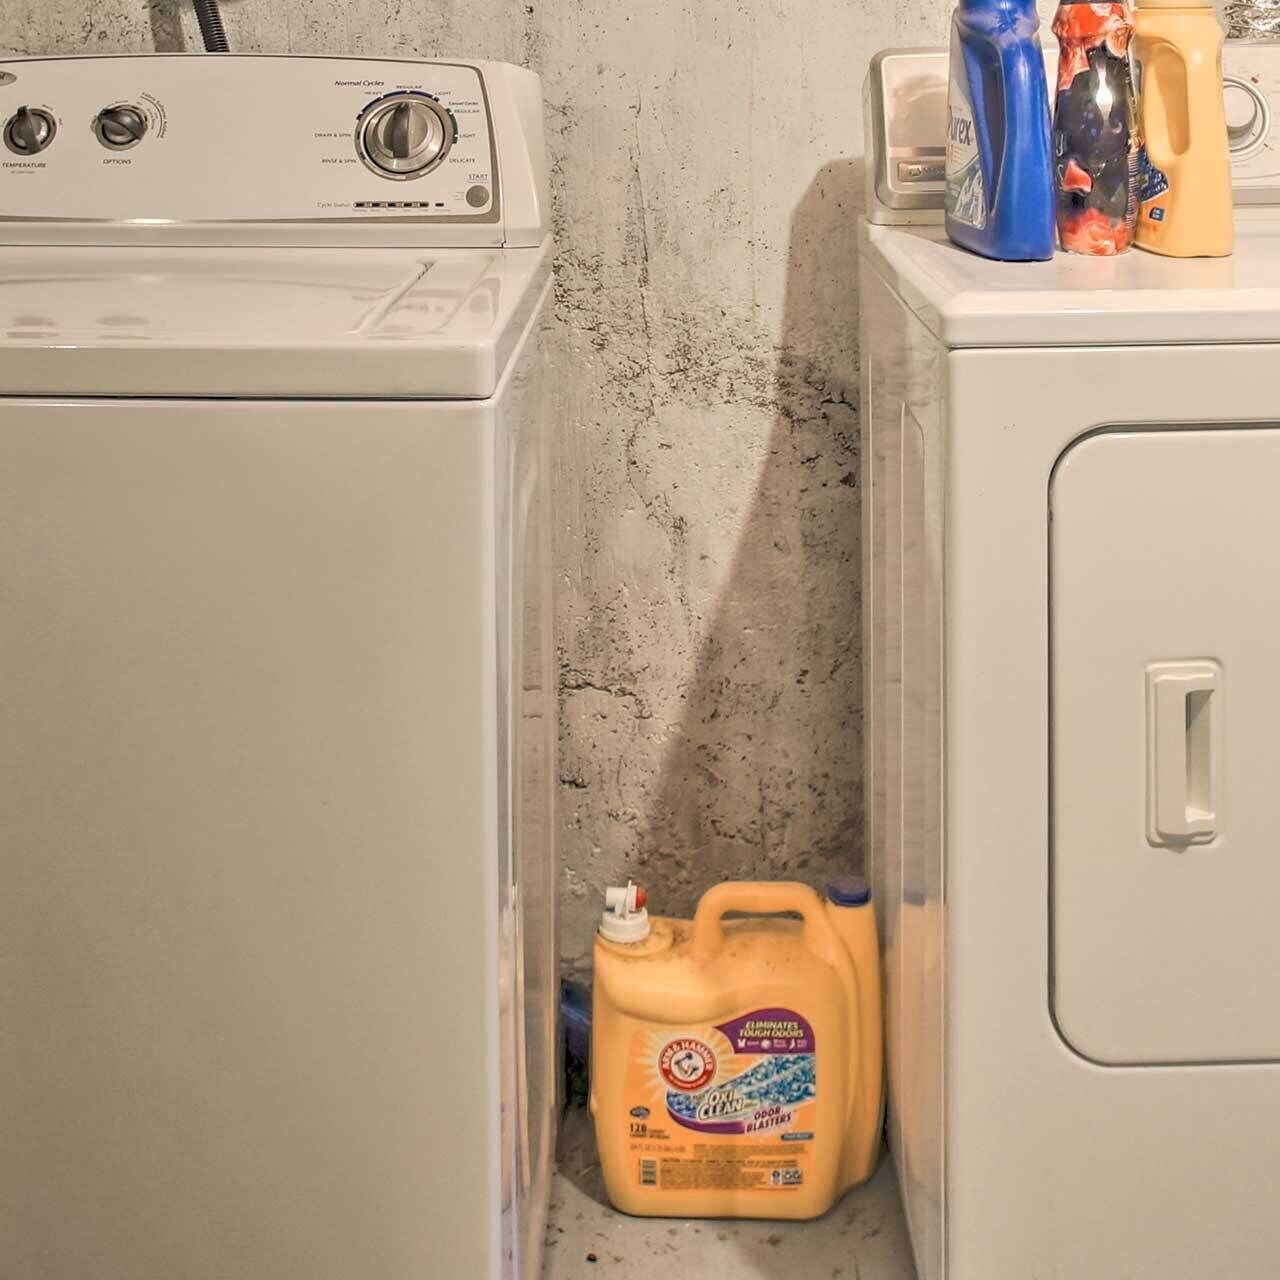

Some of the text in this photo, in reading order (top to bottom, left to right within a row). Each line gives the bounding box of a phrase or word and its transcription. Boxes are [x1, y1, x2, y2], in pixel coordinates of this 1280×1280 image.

[334, 79, 385, 88] Normal Cycles
[745, 1020, 799, 1030] ELIMINATES
[739, 1028, 804, 1039] TOUGH ODORS
[709, 1090, 735, 1106] OXI
[698, 1099, 744, 1120] CLEAN
[753, 1106, 783, 1121] ODOR
[746, 1111, 793, 1134] BLASTERS
